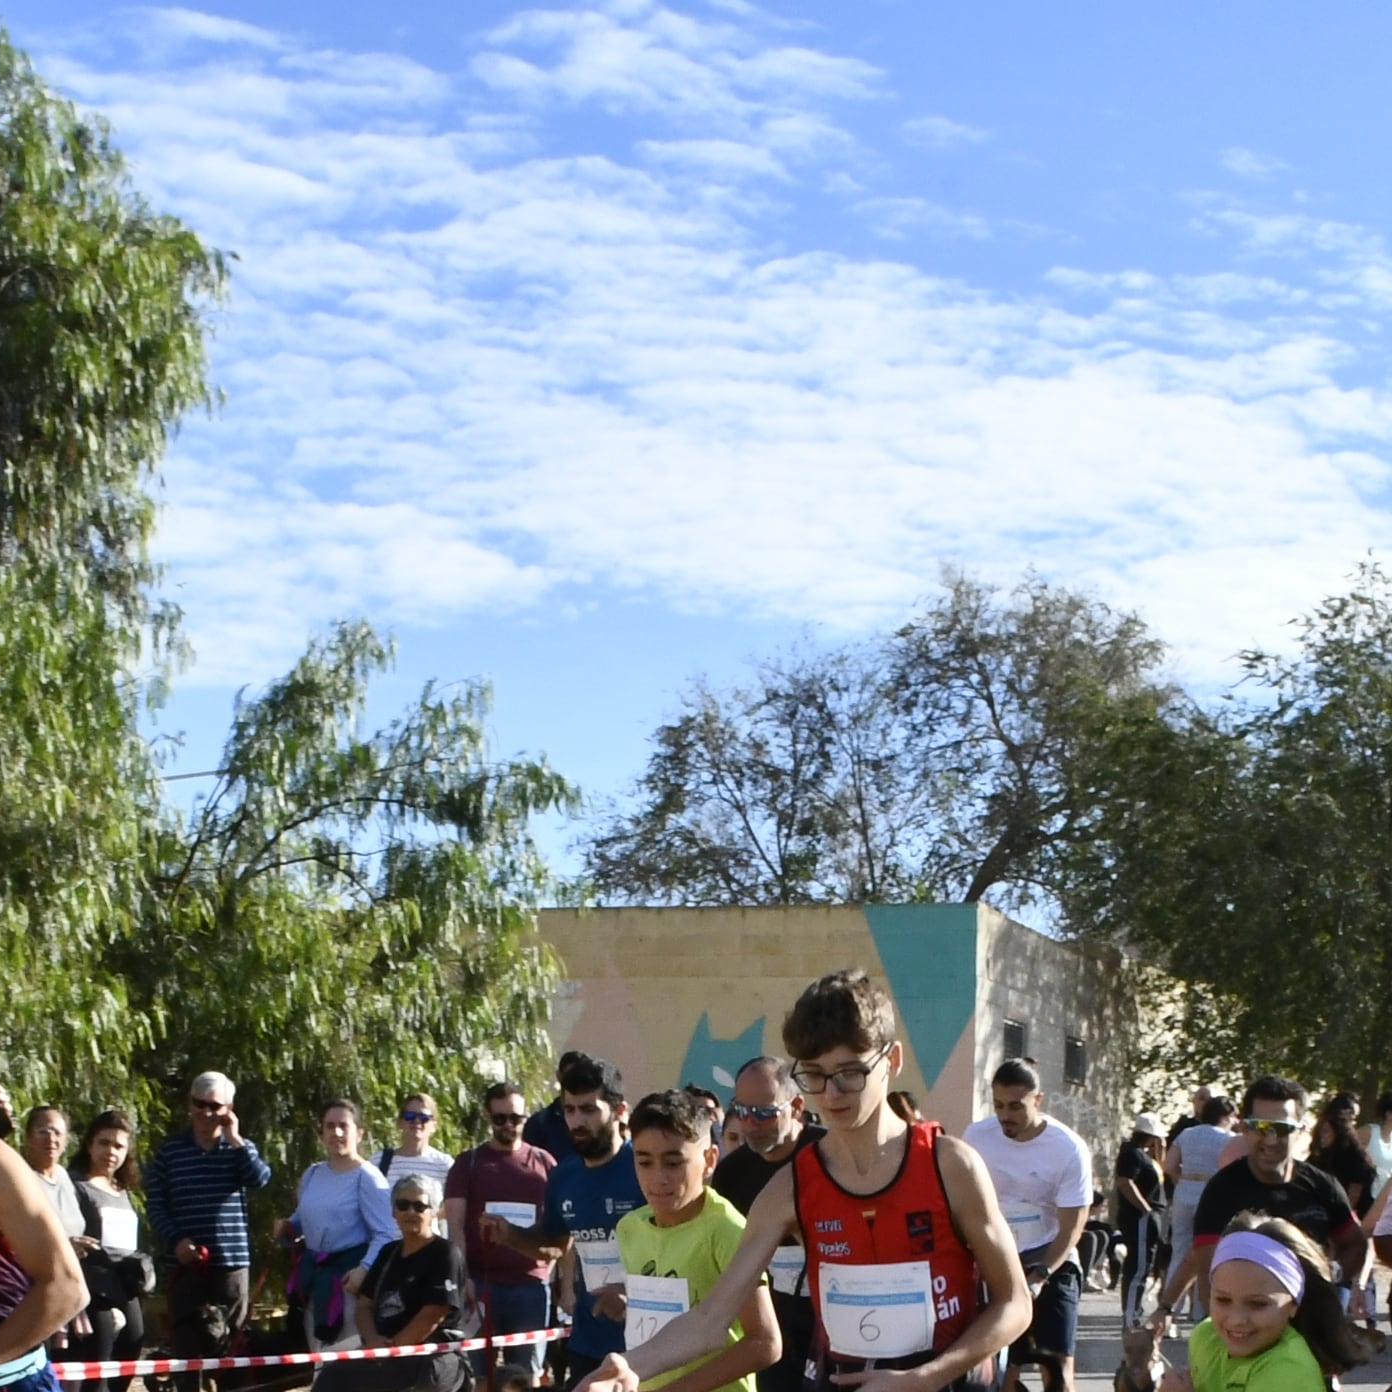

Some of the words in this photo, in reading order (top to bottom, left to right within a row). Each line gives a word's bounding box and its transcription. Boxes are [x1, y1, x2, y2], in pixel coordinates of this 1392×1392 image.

[570, 1227, 606, 1241] ROSS
[937, 1295, 960, 1321] án
[859, 1309, 881, 1342] 6
